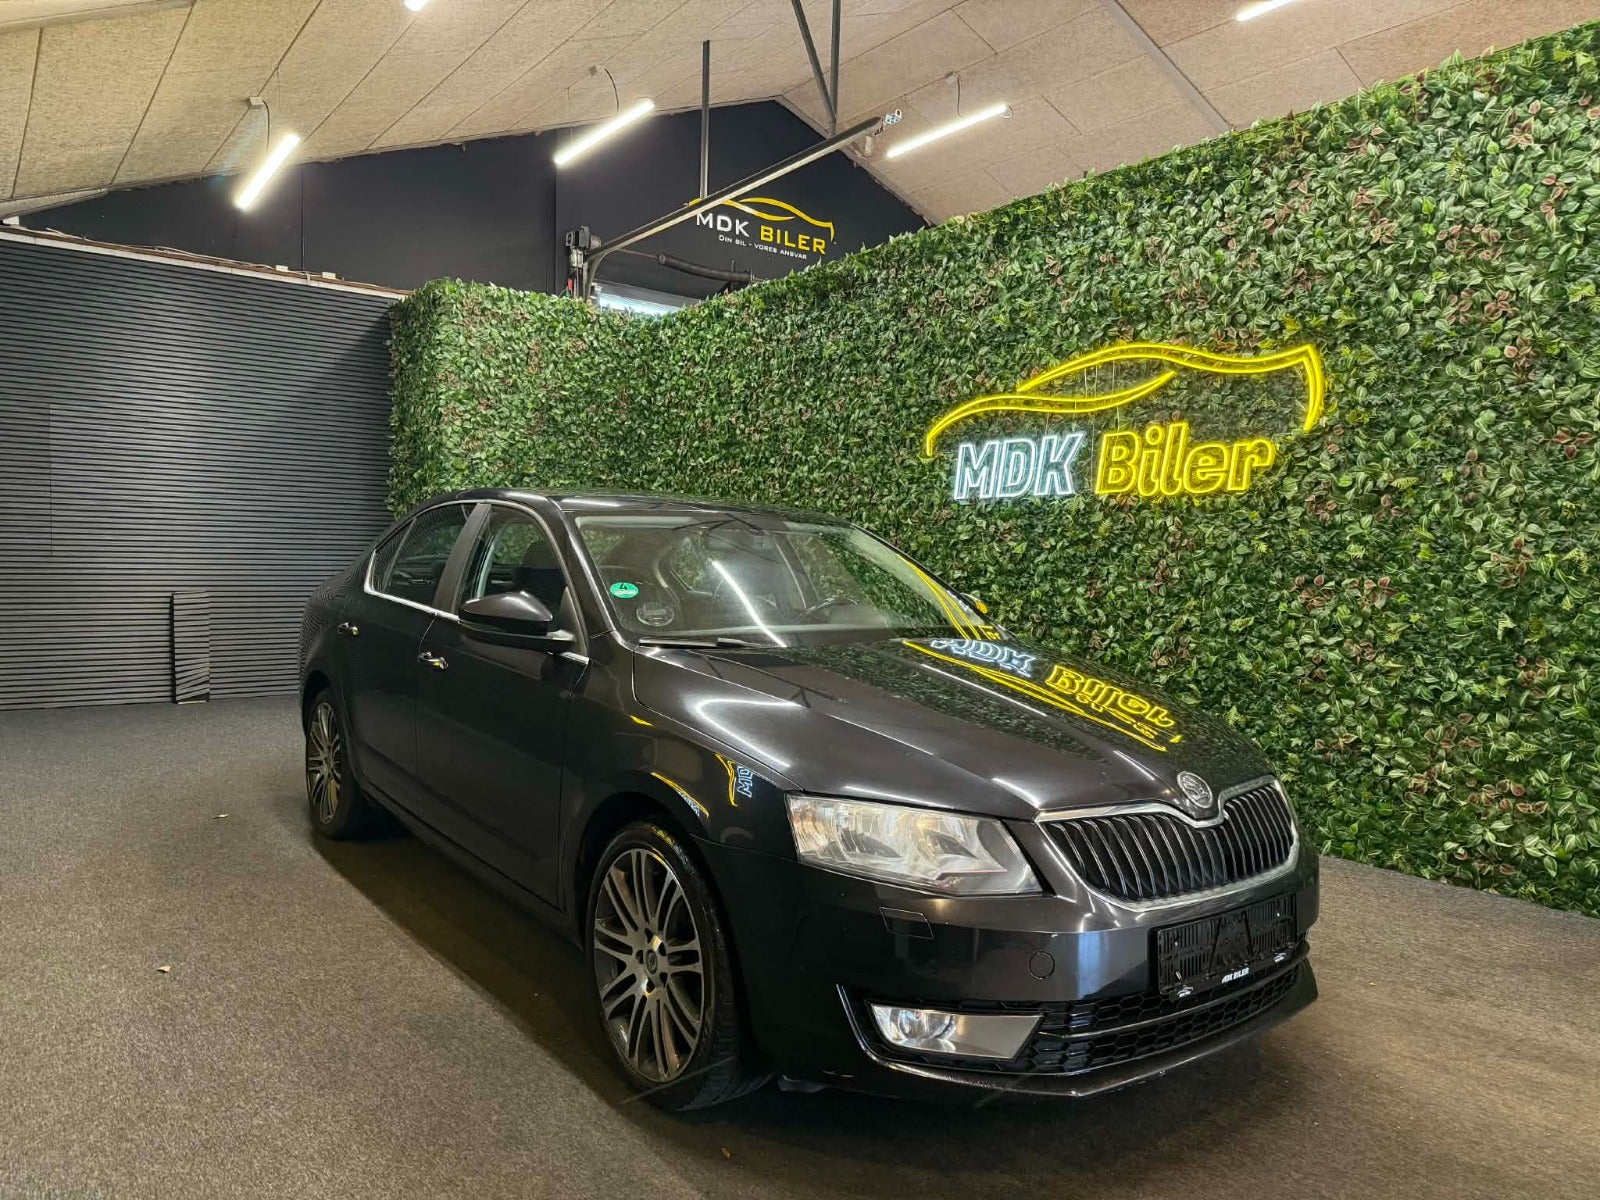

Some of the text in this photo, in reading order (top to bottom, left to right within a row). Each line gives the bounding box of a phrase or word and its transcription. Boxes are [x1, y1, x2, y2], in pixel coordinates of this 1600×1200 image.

[696, 212, 826, 255] MDK BILER
[754, 243, 778, 253] VORES
[779, 249, 807, 260] ANSVAR
[953, 421, 1277, 501] MDK Biler
